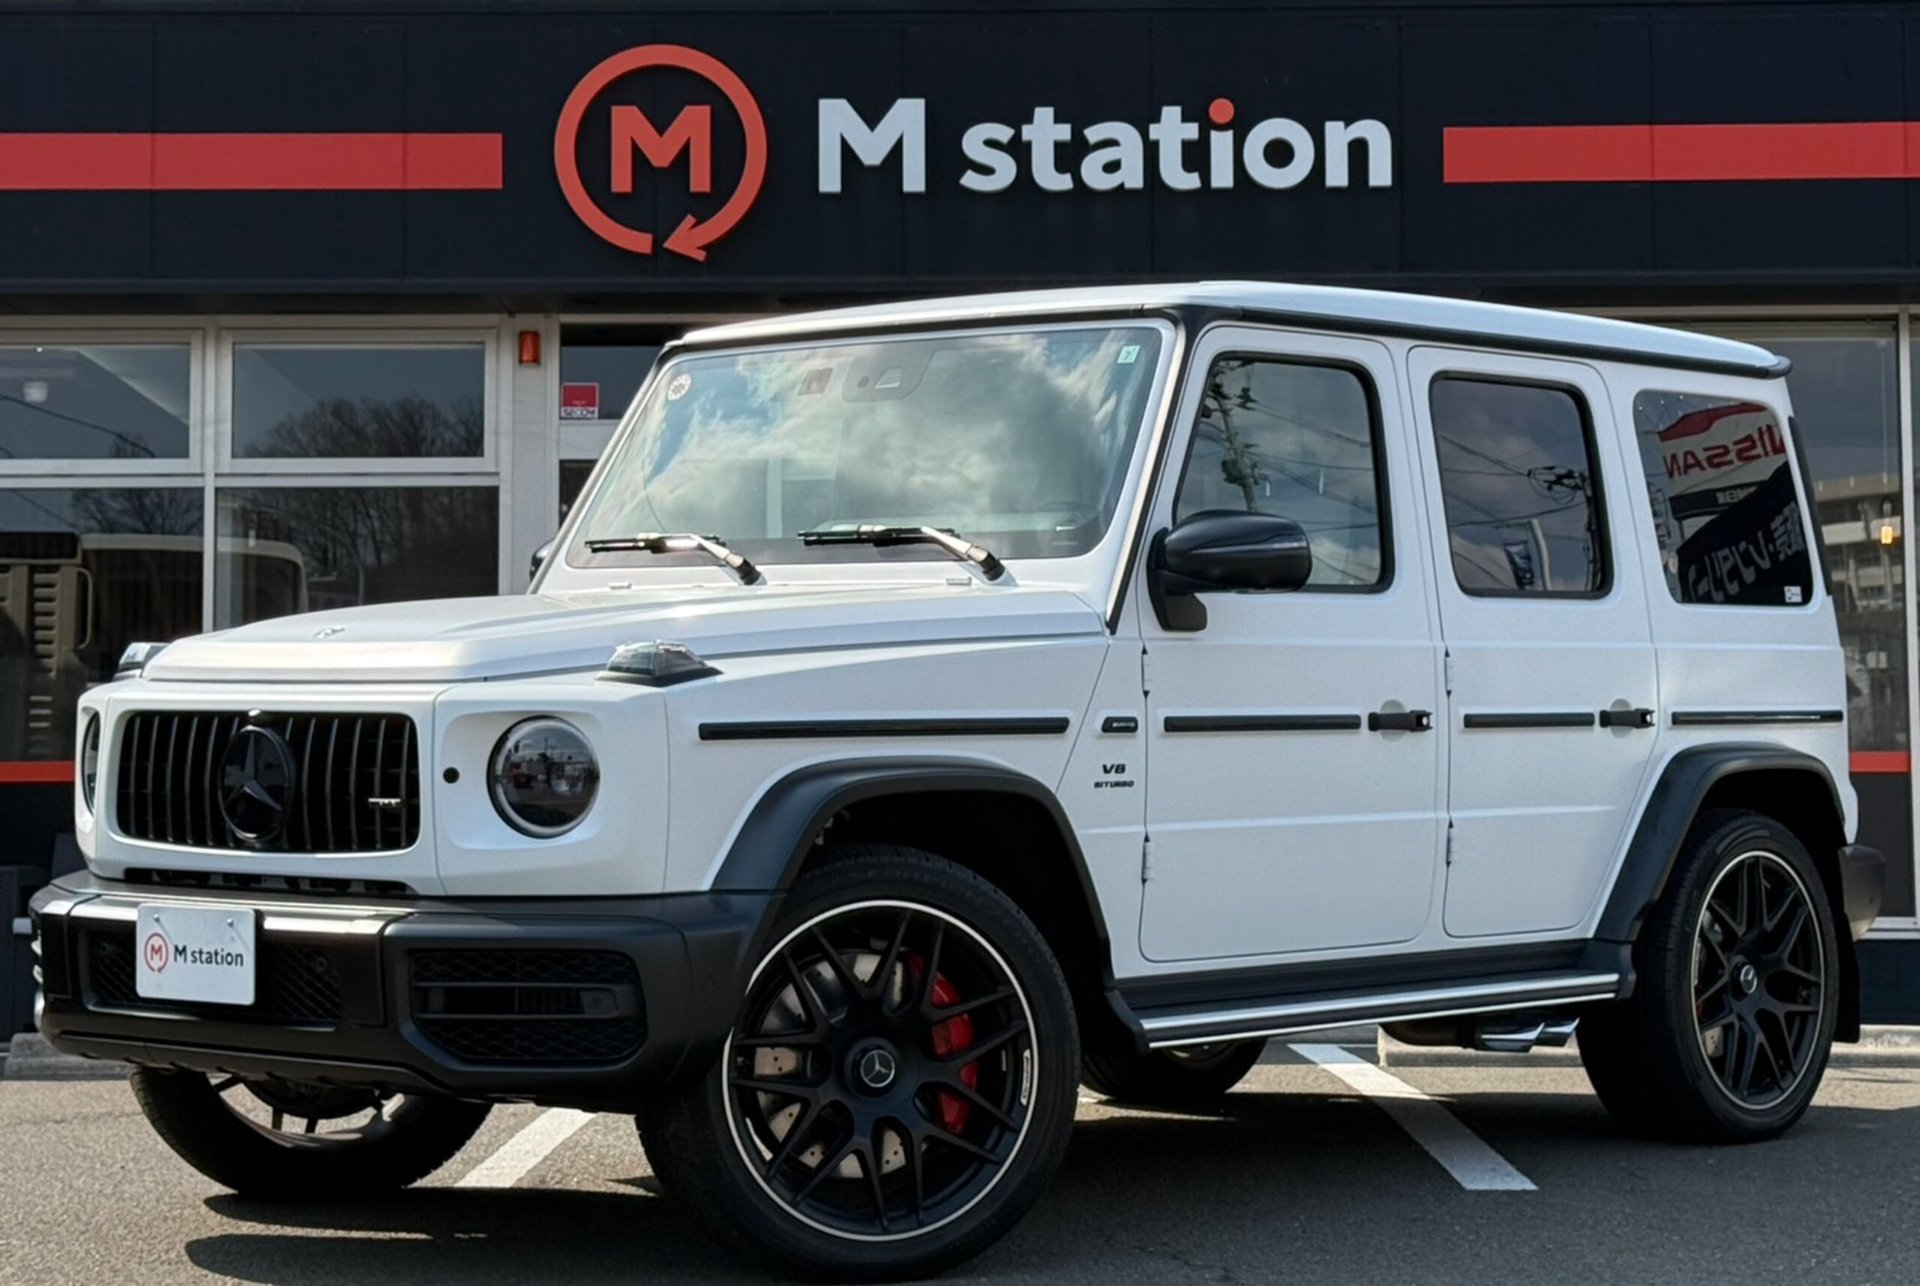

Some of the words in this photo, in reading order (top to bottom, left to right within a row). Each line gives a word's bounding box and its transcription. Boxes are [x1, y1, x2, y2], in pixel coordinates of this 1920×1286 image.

[611, 105, 711, 193] M
[818, 98, 926, 193] M
[959, 98, 1392, 192] station
[1102, 764, 1126, 775] V8
[1094, 780, 1135, 789] BITURBO
[174, 944, 187, 963] M
[190, 947, 245, 967] station
